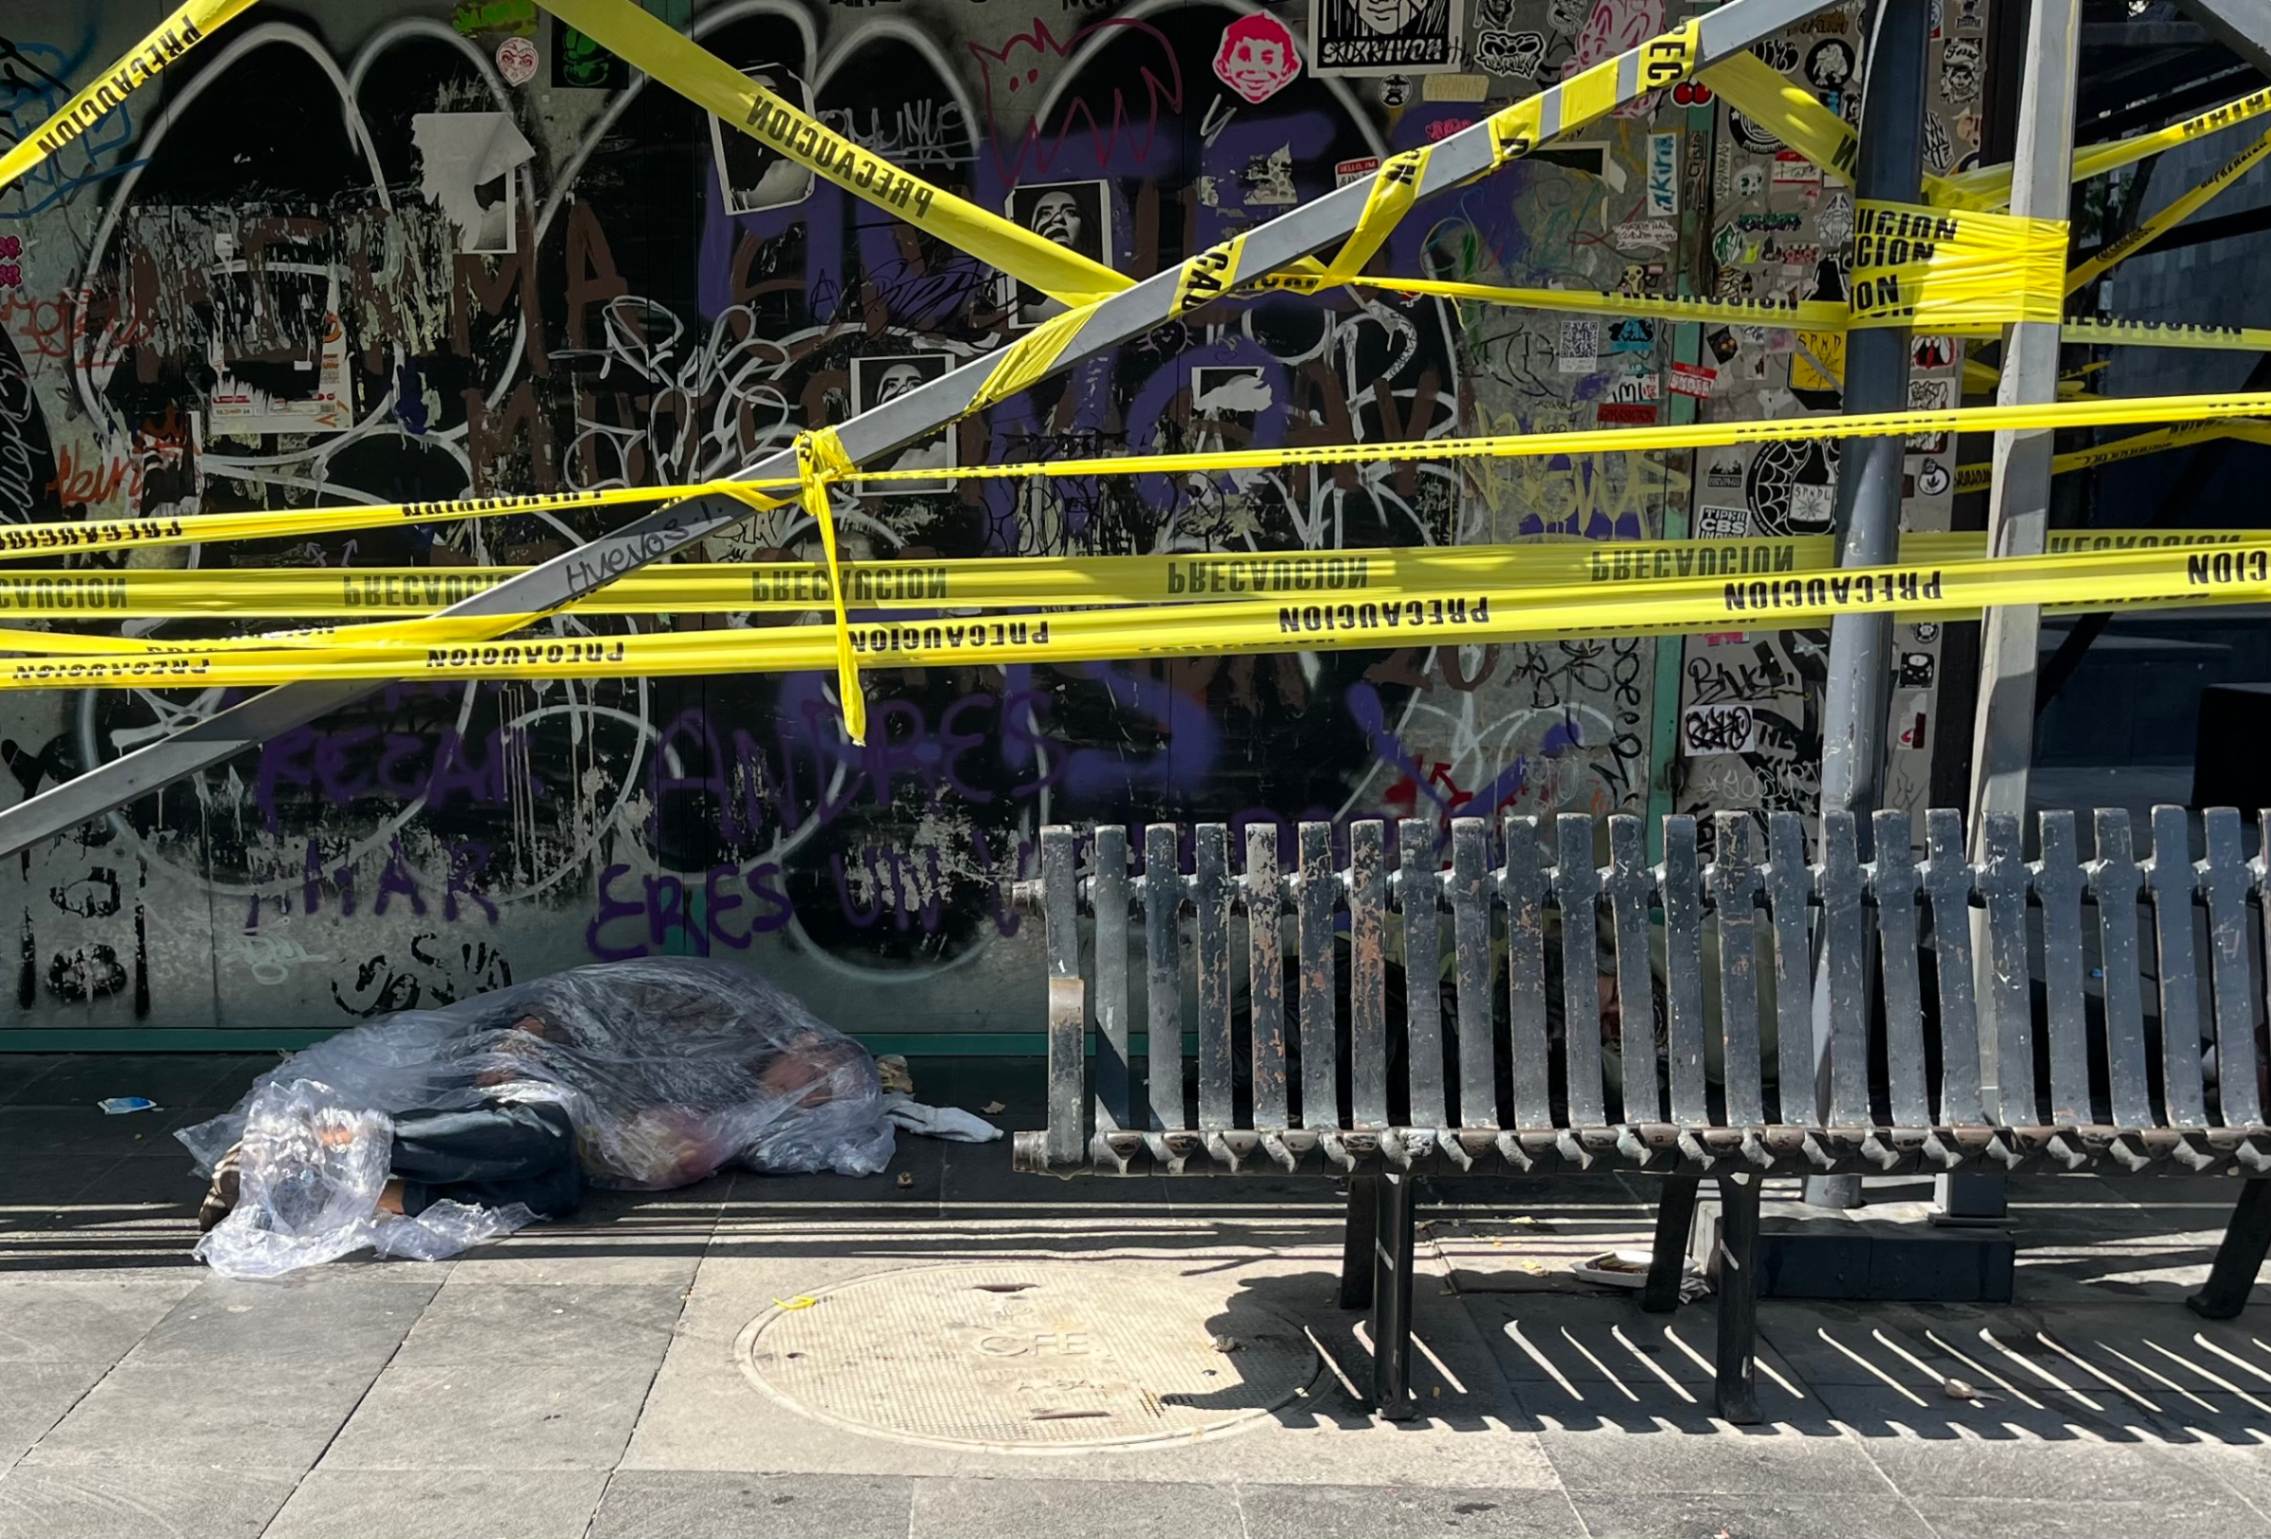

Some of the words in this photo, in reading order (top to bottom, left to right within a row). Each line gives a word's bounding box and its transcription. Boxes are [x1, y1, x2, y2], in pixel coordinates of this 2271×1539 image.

[1320, 38, 1443, 64] SURVIVOR
[36, 14, 203, 156] PRECAUCION
[0, 520, 183, 550] PRECAUCIO
[1700, 519, 1746, 534] CBS
[1723, 570, 1943, 612] PRECAUCION
[1279, 596, 1490, 634] PRECAUCION
[850, 621, 1049, 653] PRECAUCION
[427, 642, 625, 668] PRECAUCION
[586, 863, 794, 960] ERES
[976, 1332, 1090, 1358] CFE
